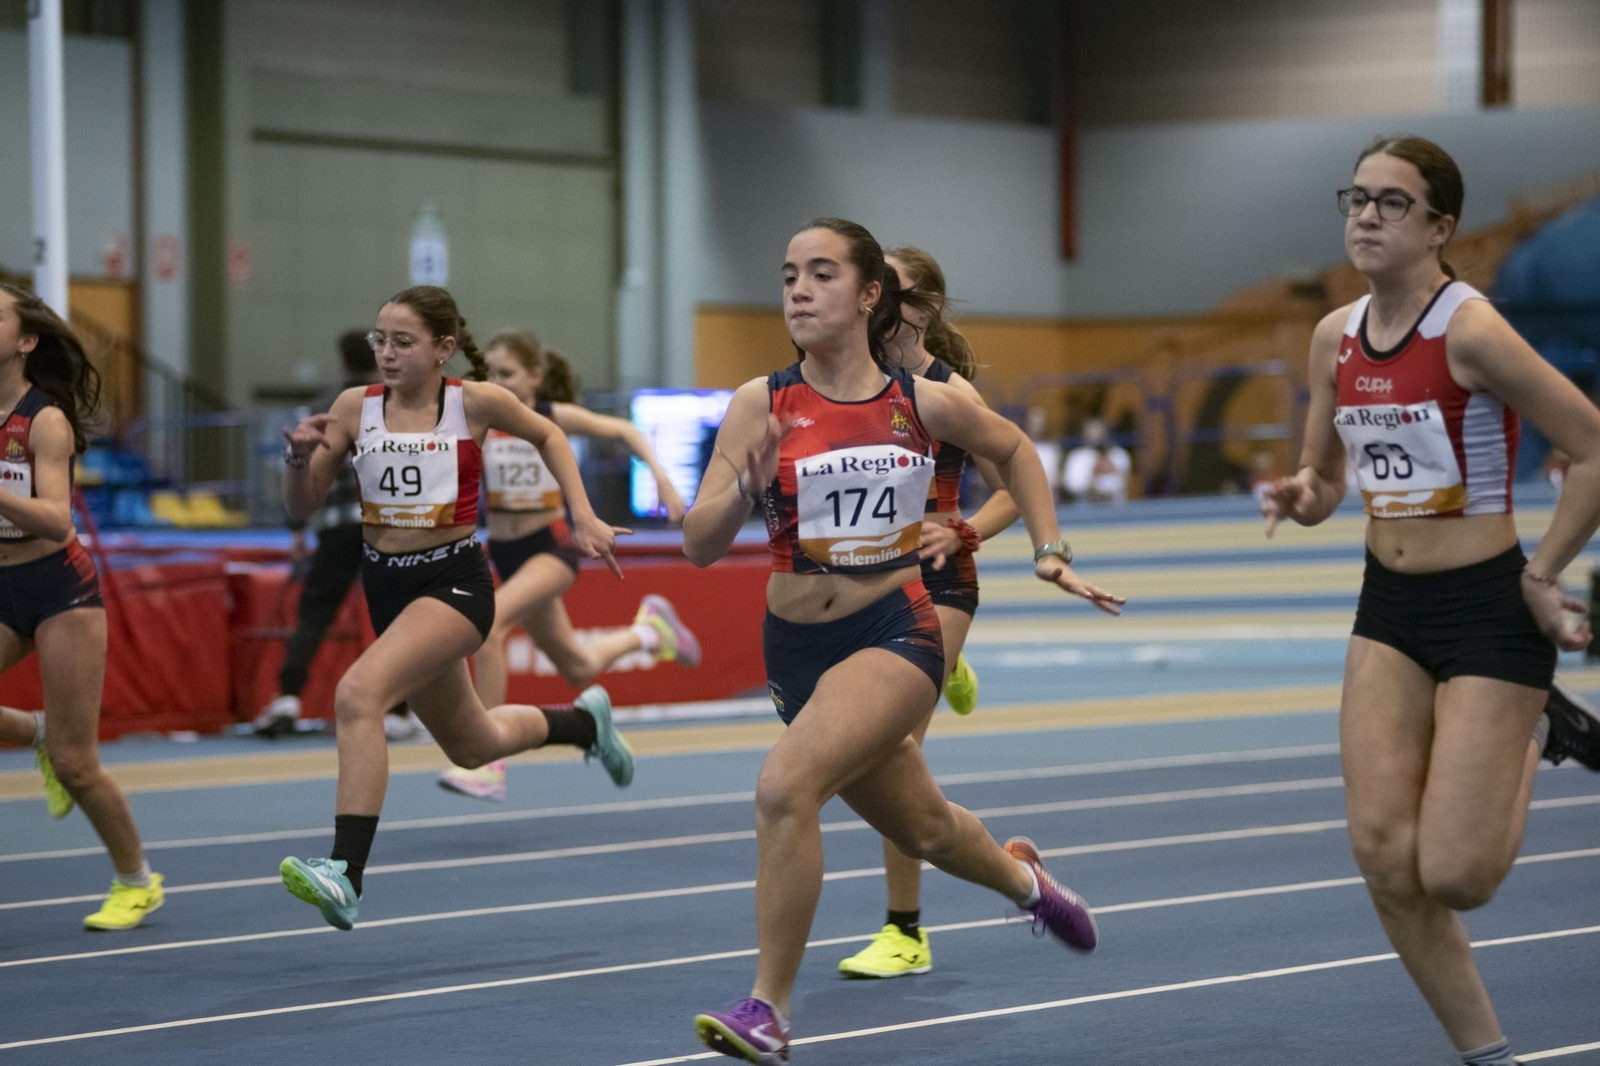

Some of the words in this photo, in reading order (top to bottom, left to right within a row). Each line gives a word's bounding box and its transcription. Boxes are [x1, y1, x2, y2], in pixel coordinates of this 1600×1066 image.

[802, 462, 834, 477] La
[1364, 443, 1413, 480] 63
[379, 466, 422, 497] 49
[498, 462, 541, 487] 123
[825, 486, 898, 528] 174
[387, 545, 450, 567] NIKE
[830, 547, 902, 566] telemiño
